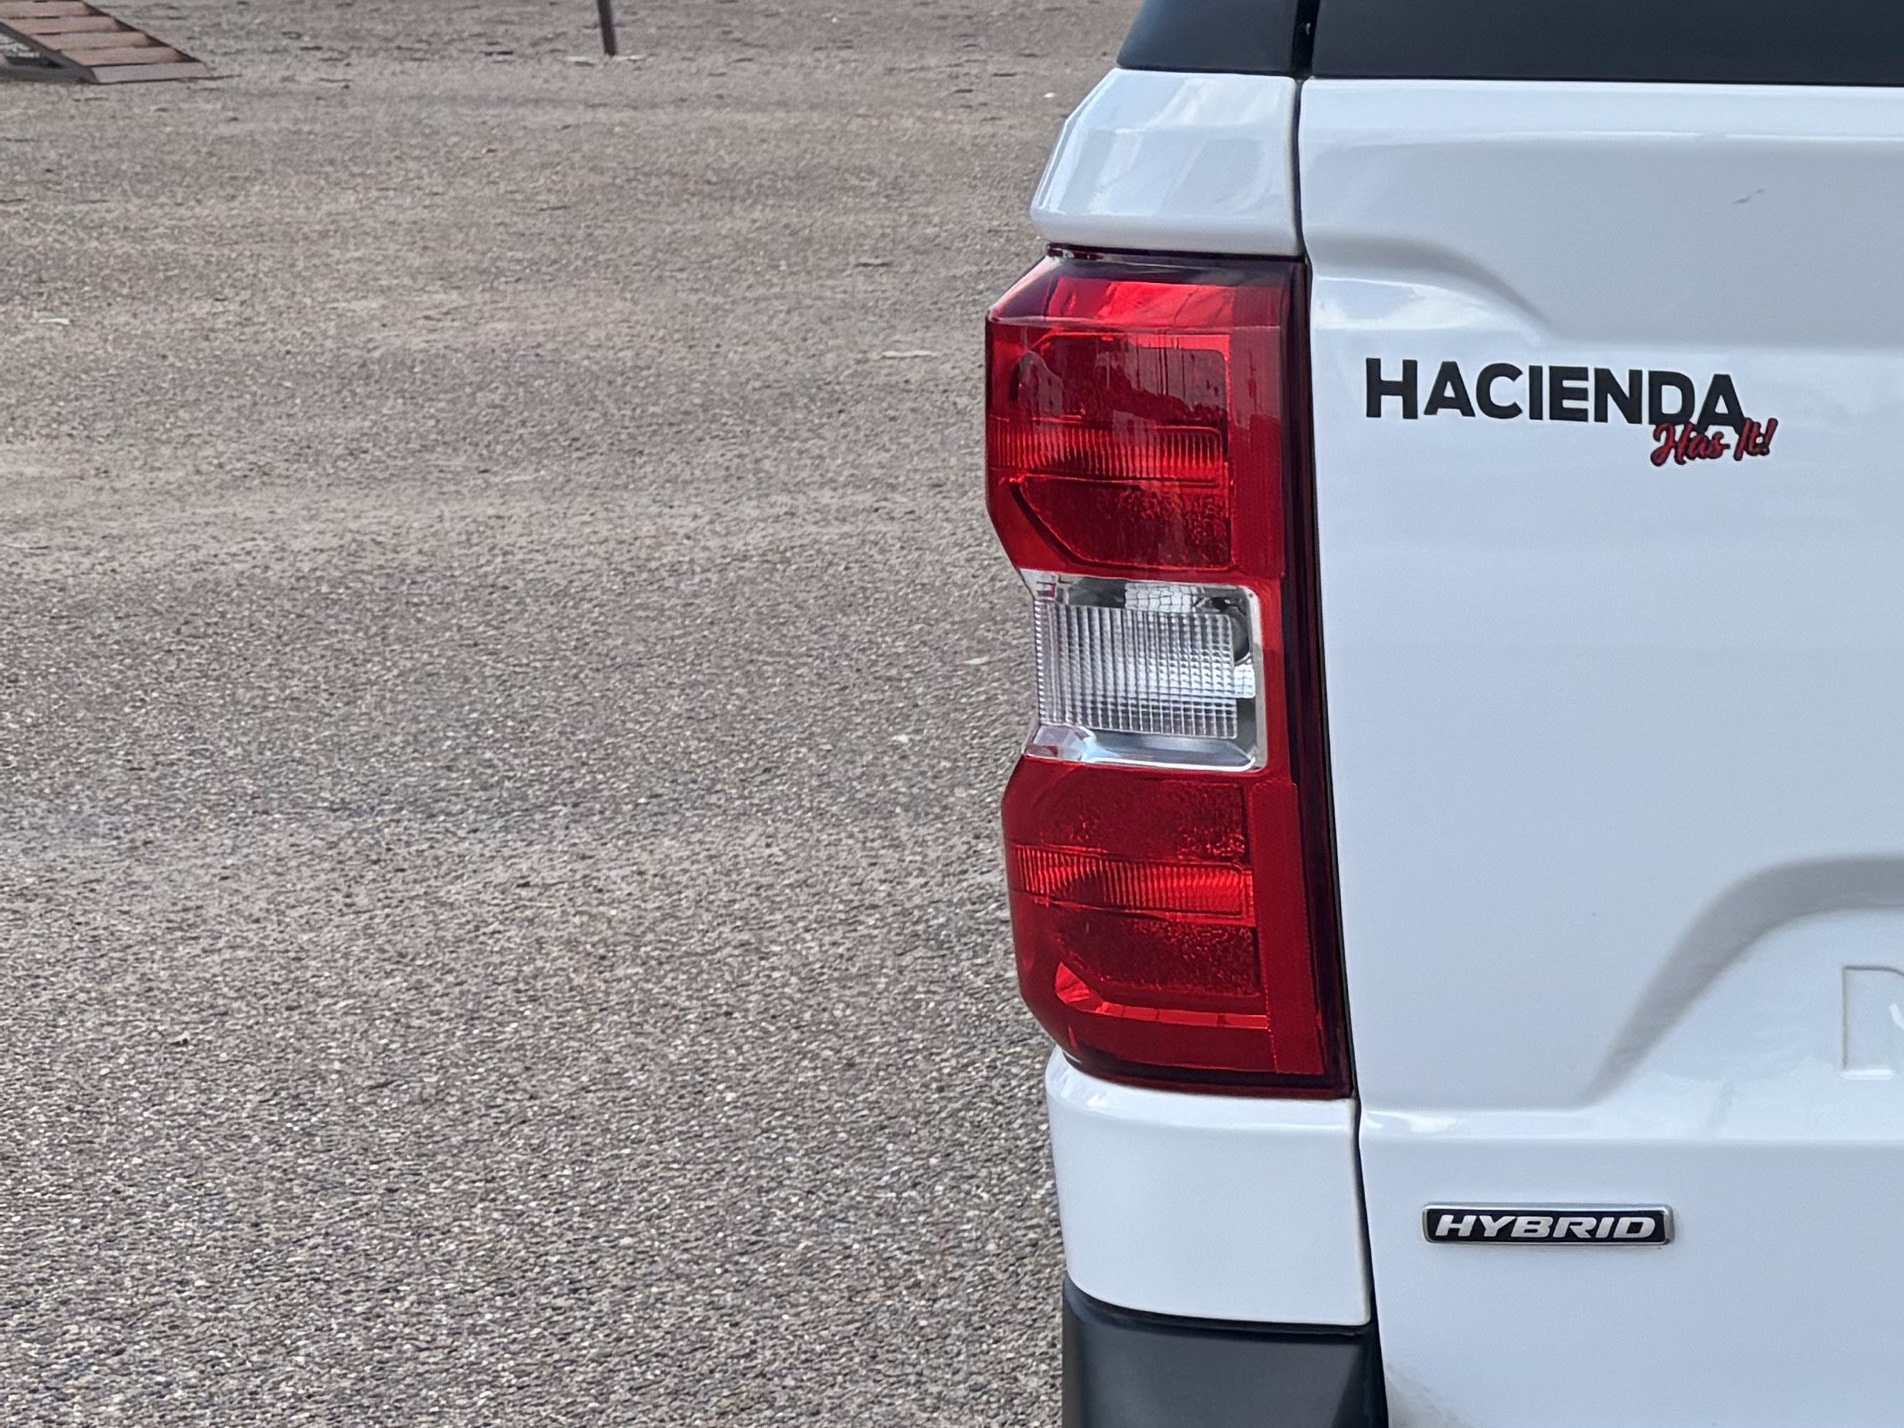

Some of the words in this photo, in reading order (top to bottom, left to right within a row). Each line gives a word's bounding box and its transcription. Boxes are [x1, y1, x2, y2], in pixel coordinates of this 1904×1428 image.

[1365, 357, 1747, 435] HACIENDA
[1649, 421, 1732, 467] Has
[1435, 1214, 1657, 1239] HYBRID
